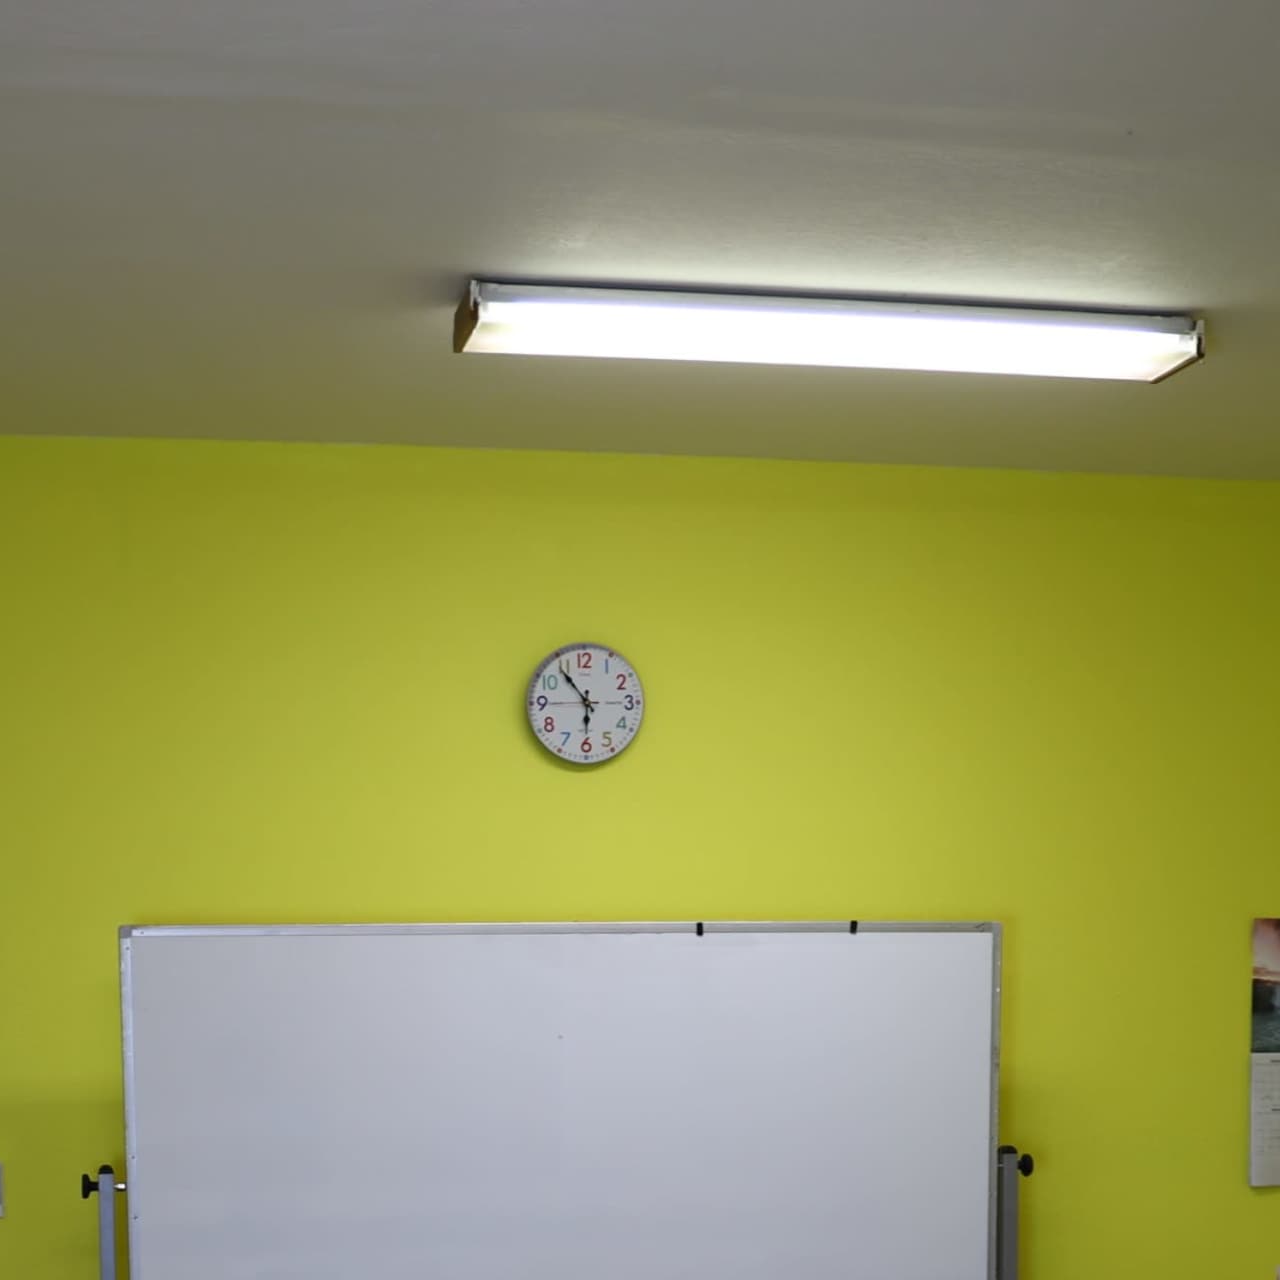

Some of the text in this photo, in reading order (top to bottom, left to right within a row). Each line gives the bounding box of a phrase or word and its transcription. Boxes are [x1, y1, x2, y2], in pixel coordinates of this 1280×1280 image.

[577, 652, 592, 669] 12
[605, 659, 609, 674] 1
[542, 674, 558, 691] 10
[616, 674, 627, 690] 2
[536, 695, 548, 711] 9
[624, 695, 634, 710] 3
[544, 716, 554, 733] 8
[616, 717, 627, 729] 4
[560, 732, 571, 746] 7
[581, 737, 592, 753] 6
[602, 732, 612, 748] 5
